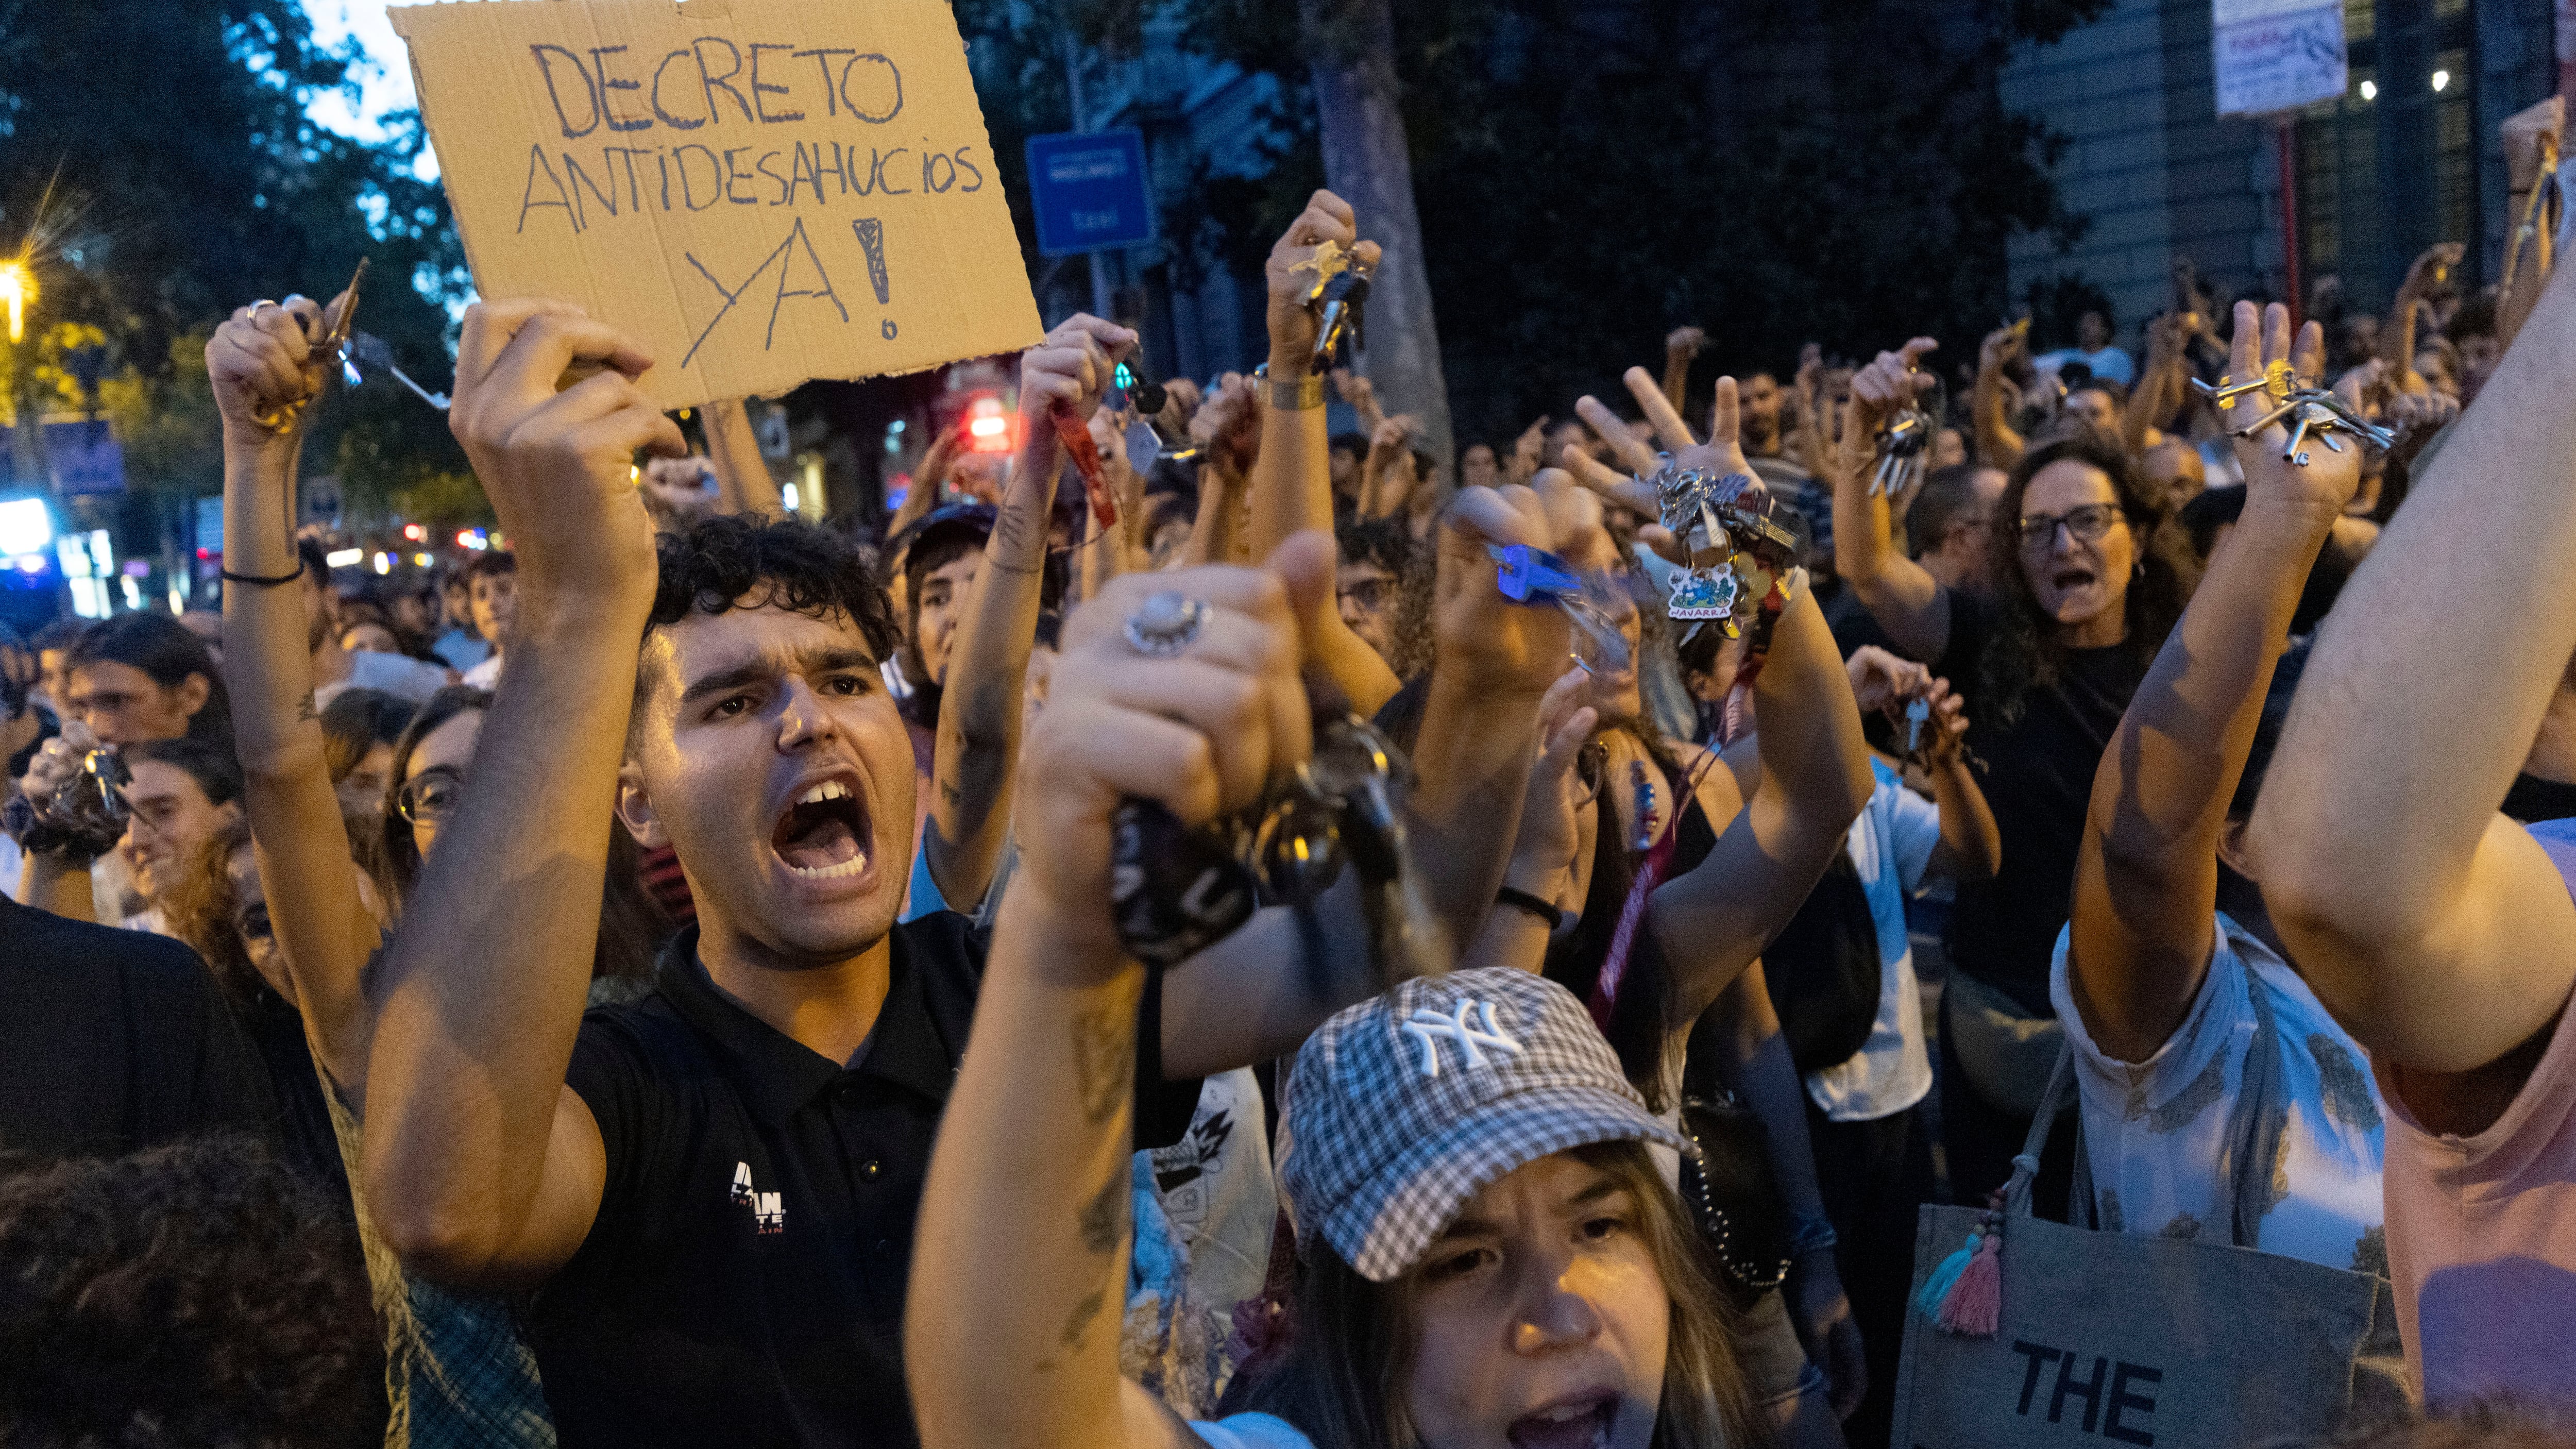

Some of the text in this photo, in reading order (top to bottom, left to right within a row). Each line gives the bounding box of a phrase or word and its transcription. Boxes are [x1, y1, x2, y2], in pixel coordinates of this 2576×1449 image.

[530, 37, 903, 138] DECRETO
[682, 216, 897, 368] YA!
[1671, 608, 1727, 616] NAVARRA
[1401, 998, 1523, 1076] NY
[2013, 1341, 2163, 1447] THE
